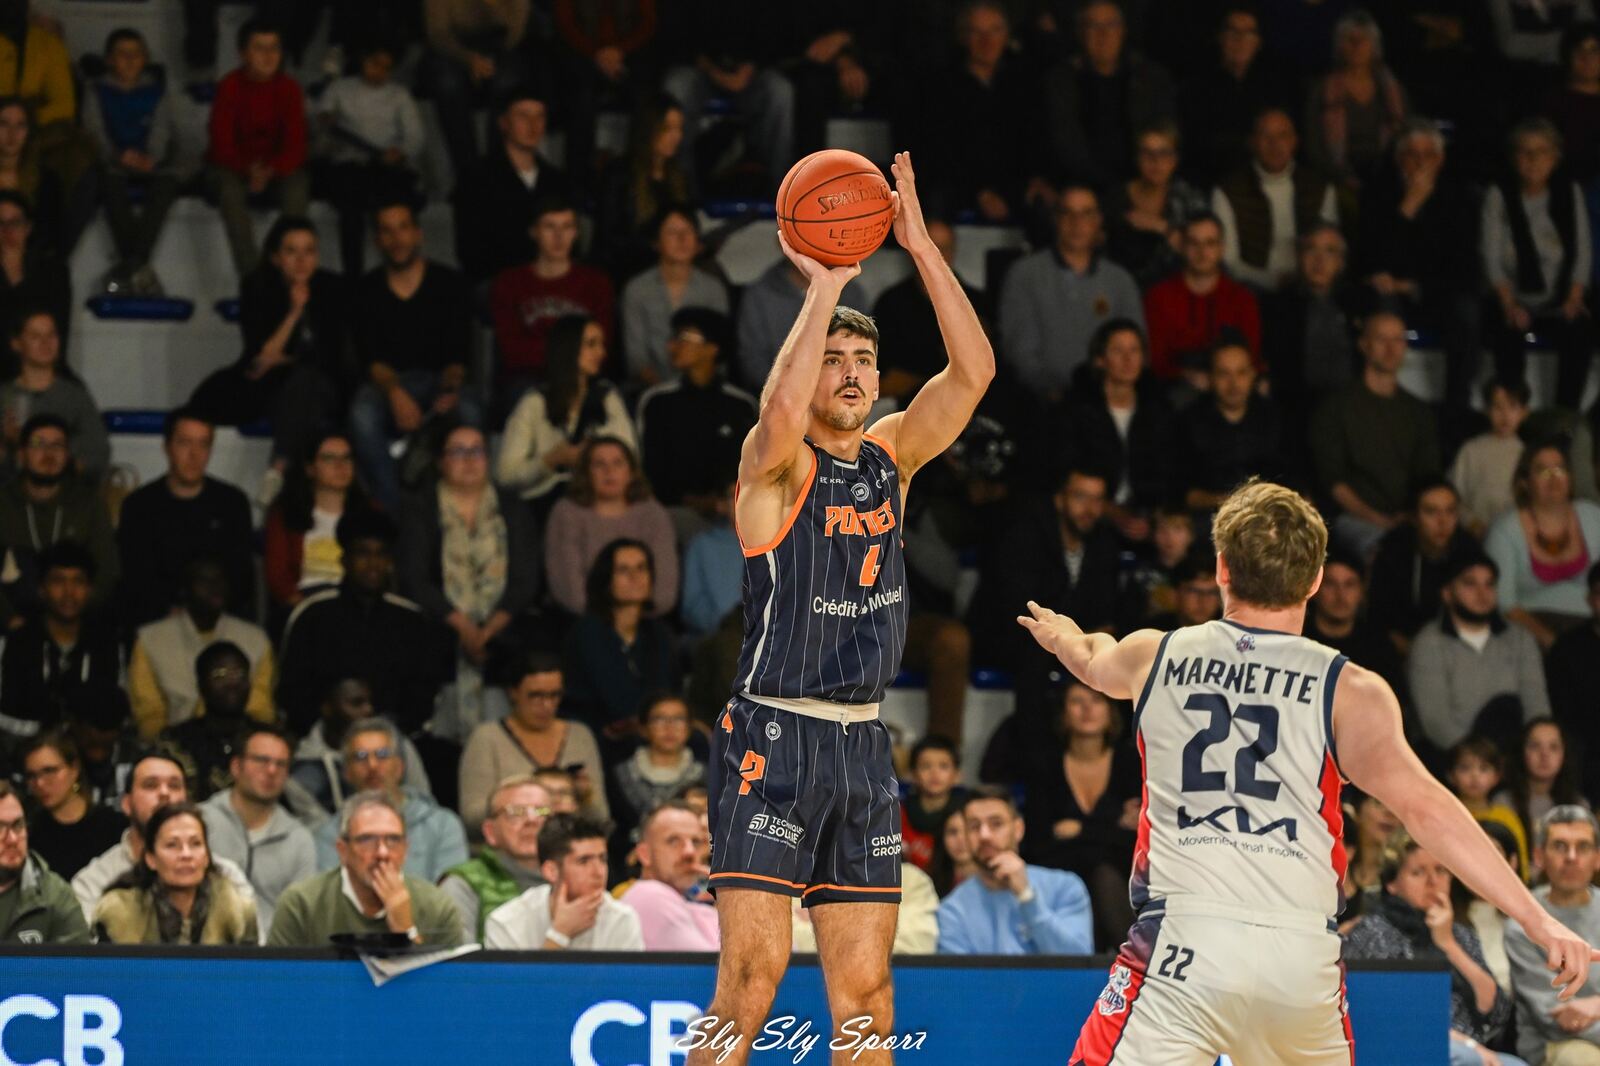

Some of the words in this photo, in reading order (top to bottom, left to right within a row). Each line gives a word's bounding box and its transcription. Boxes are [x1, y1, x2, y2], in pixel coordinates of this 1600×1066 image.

[817, 184, 889, 215] SPALDING
[813, 596, 858, 618] Crédit
[1164, 657, 1318, 705] MARNETTE
[1181, 693, 1281, 802] 22
[1158, 944, 1195, 981] 22
